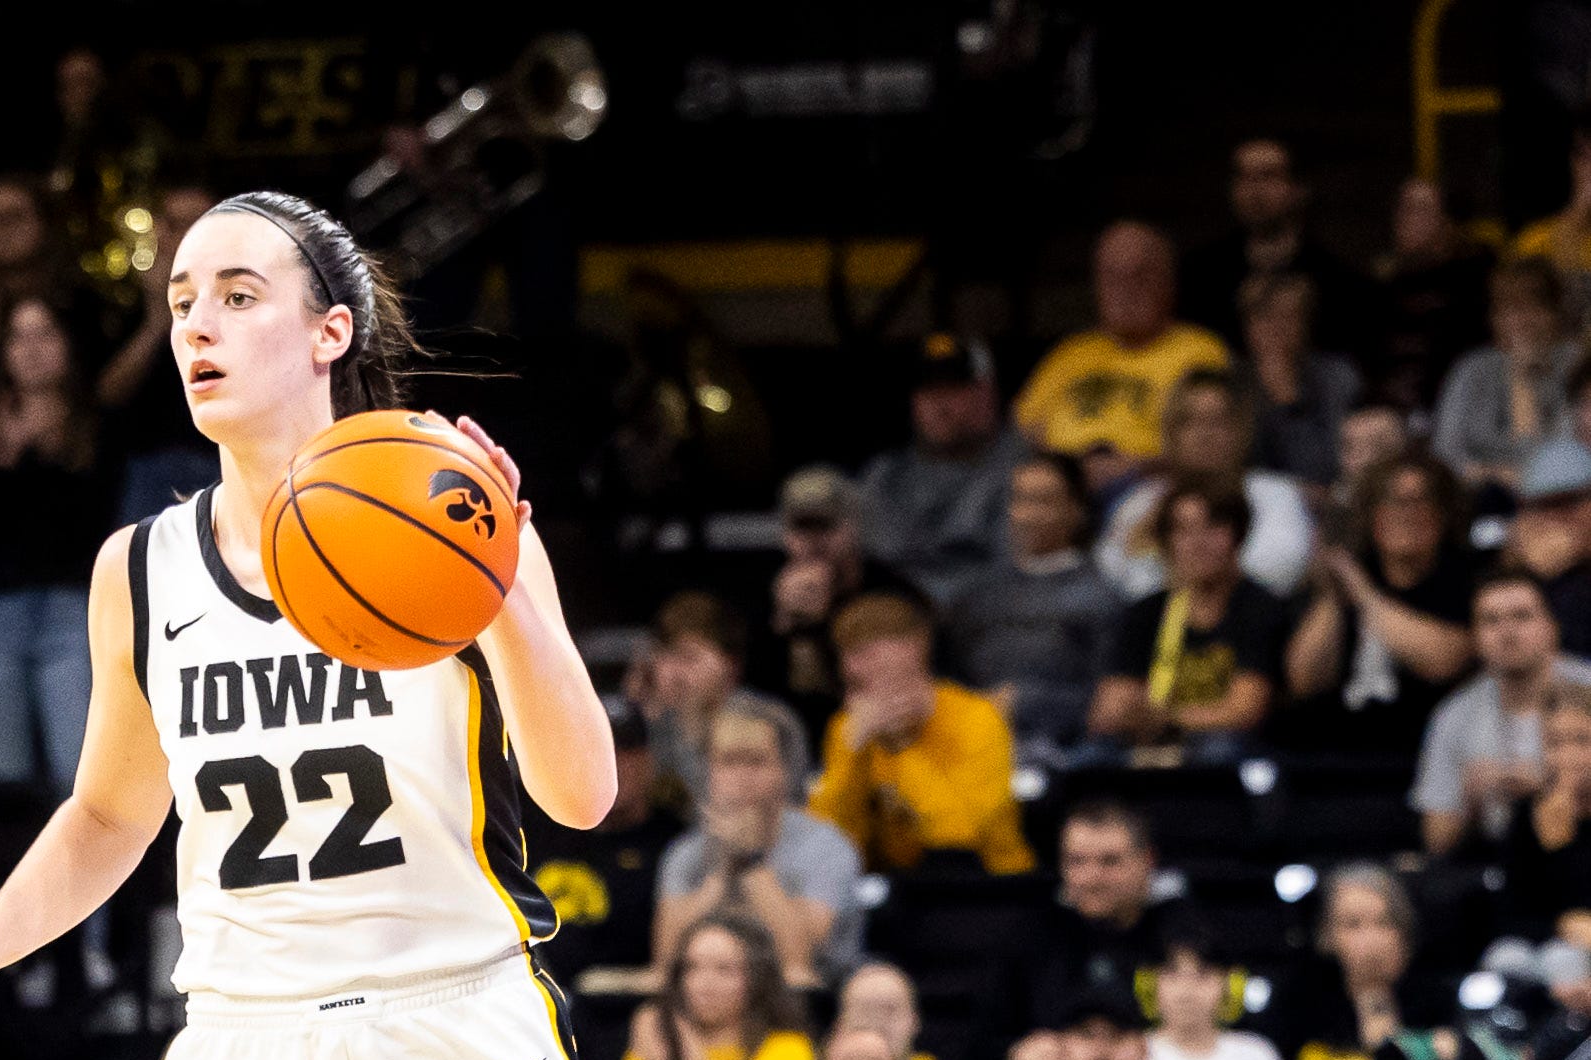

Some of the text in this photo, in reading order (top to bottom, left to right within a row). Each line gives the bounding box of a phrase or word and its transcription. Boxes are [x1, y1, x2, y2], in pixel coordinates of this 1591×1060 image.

[179, 652, 394, 738] IOWA
[195, 744, 406, 890] 22
[319, 997, 366, 1011] HAWKEYES
